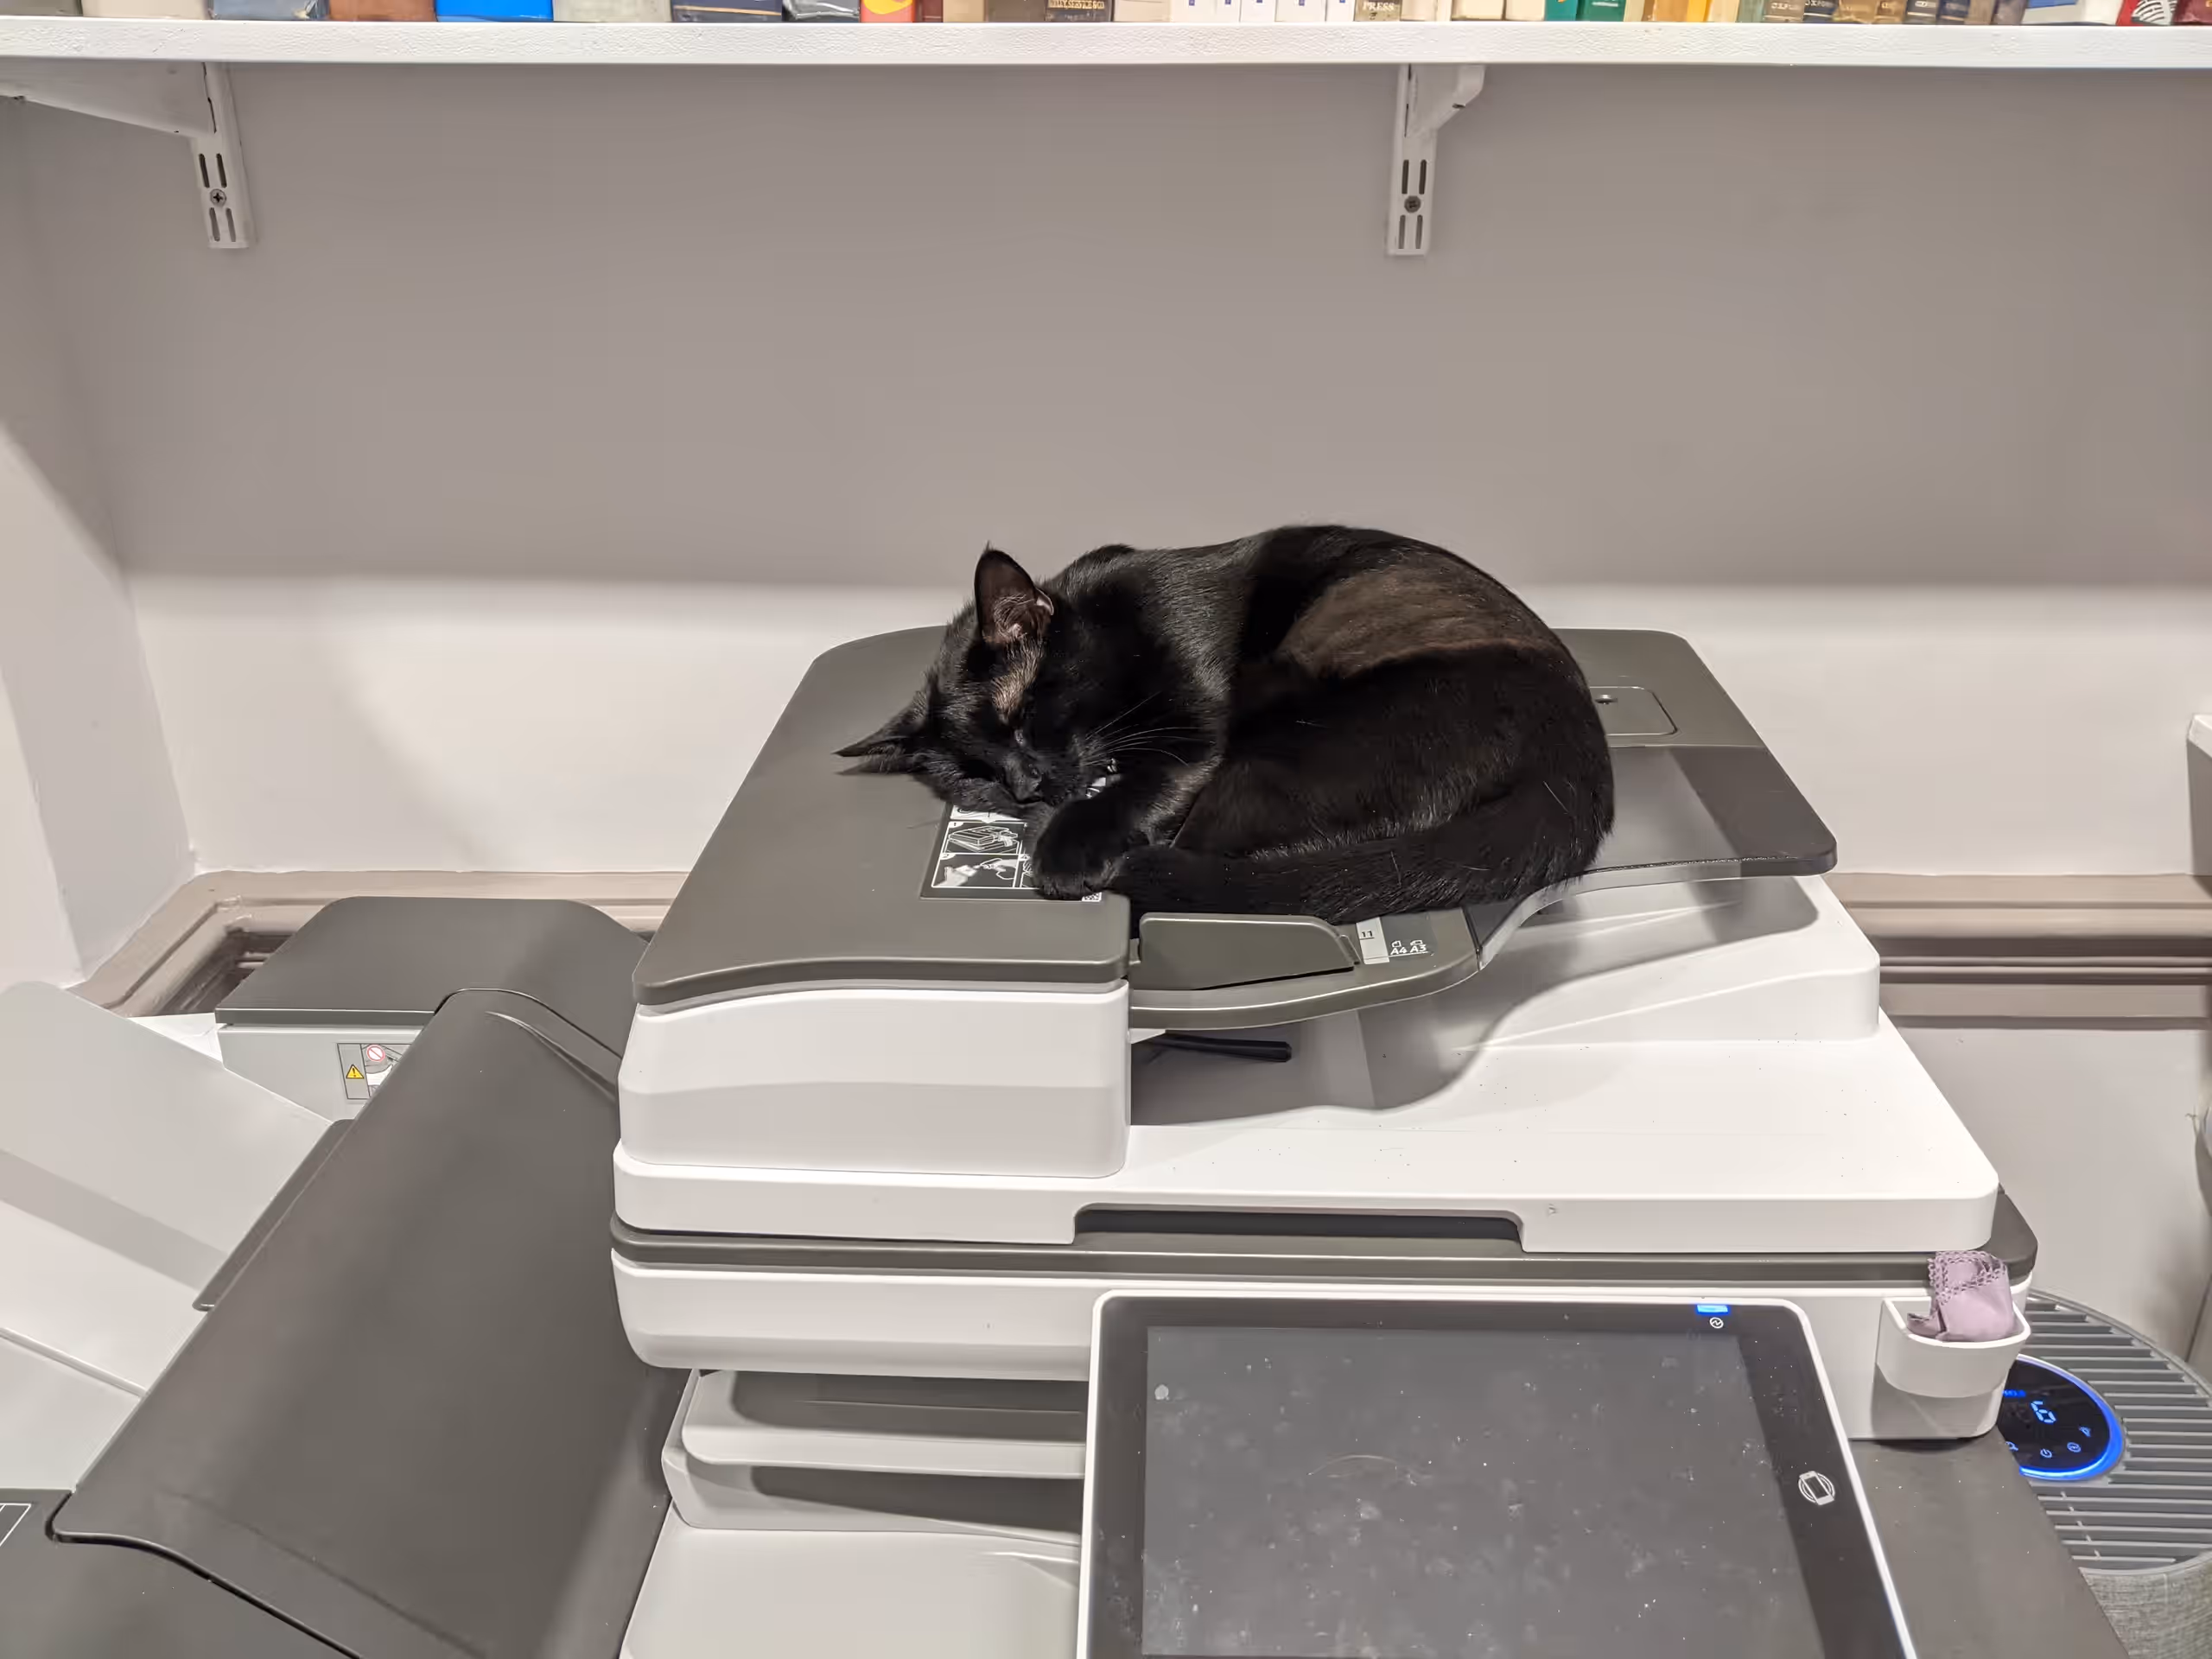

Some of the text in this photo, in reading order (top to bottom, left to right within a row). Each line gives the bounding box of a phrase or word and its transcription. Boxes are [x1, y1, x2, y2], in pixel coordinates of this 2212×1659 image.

[1363, 2, 1395, 11] PRESS
[1390, 944, 1427, 956] A4 A3
[2031, 1401, 2056, 1424] 6
